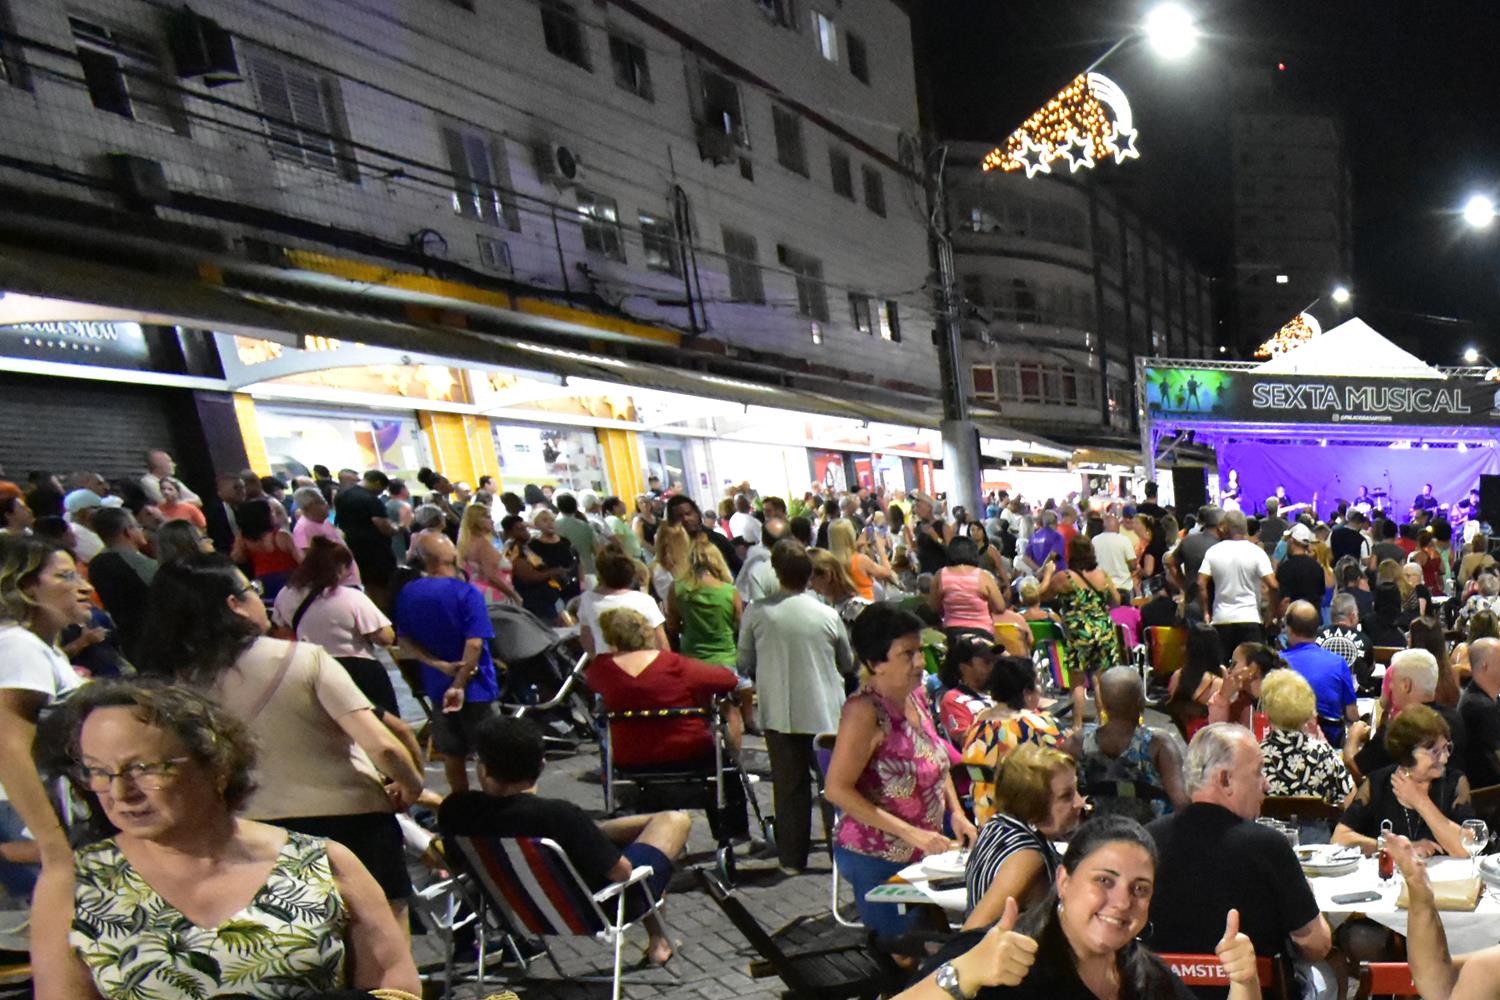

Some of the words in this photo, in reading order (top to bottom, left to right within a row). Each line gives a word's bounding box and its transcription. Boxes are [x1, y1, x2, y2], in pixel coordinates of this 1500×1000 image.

[1252, 383, 1342, 411] SEXTA
[1345, 386, 1471, 414] MUSICAL
[1171, 964, 1230, 978] AMSTE
